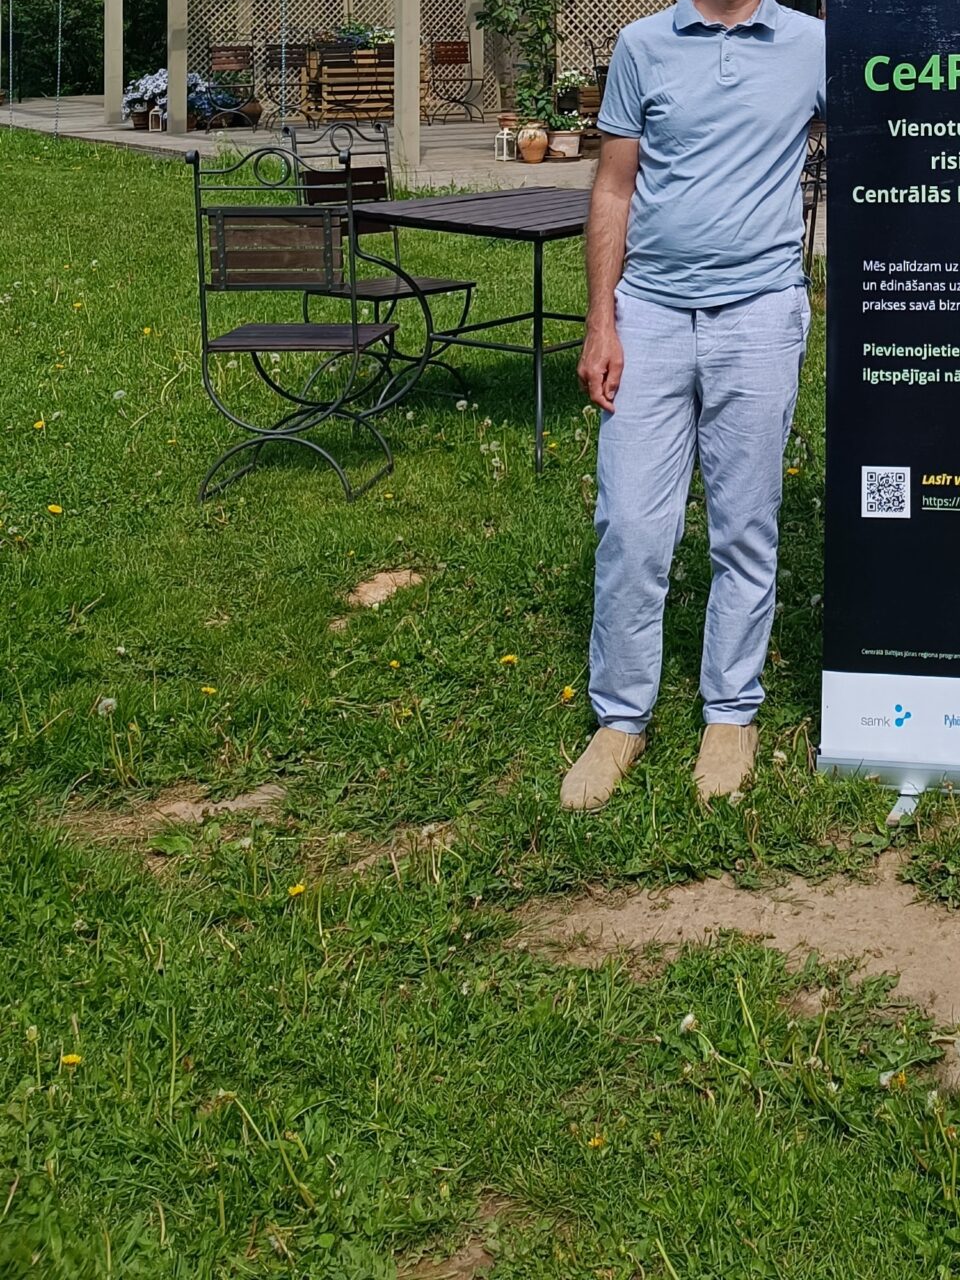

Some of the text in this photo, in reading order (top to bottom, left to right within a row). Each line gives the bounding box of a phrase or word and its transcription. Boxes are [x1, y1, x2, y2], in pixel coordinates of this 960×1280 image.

[852, 184, 951, 203] Centrālās
[863, 260, 886, 272] Mēs
[889, 260, 942, 275] palīdzam
[945, 262, 959, 272] uz
[862, 281, 877, 291] un
[880, 279, 946, 292] ēdināšanas
[862, 299, 906, 313] prakses
[909, 300, 936, 311] savā
[862, 368, 940, 385] ilgtspējīgai
[922, 473, 952, 486] LASĪT
[861, 715, 891, 728] samk
